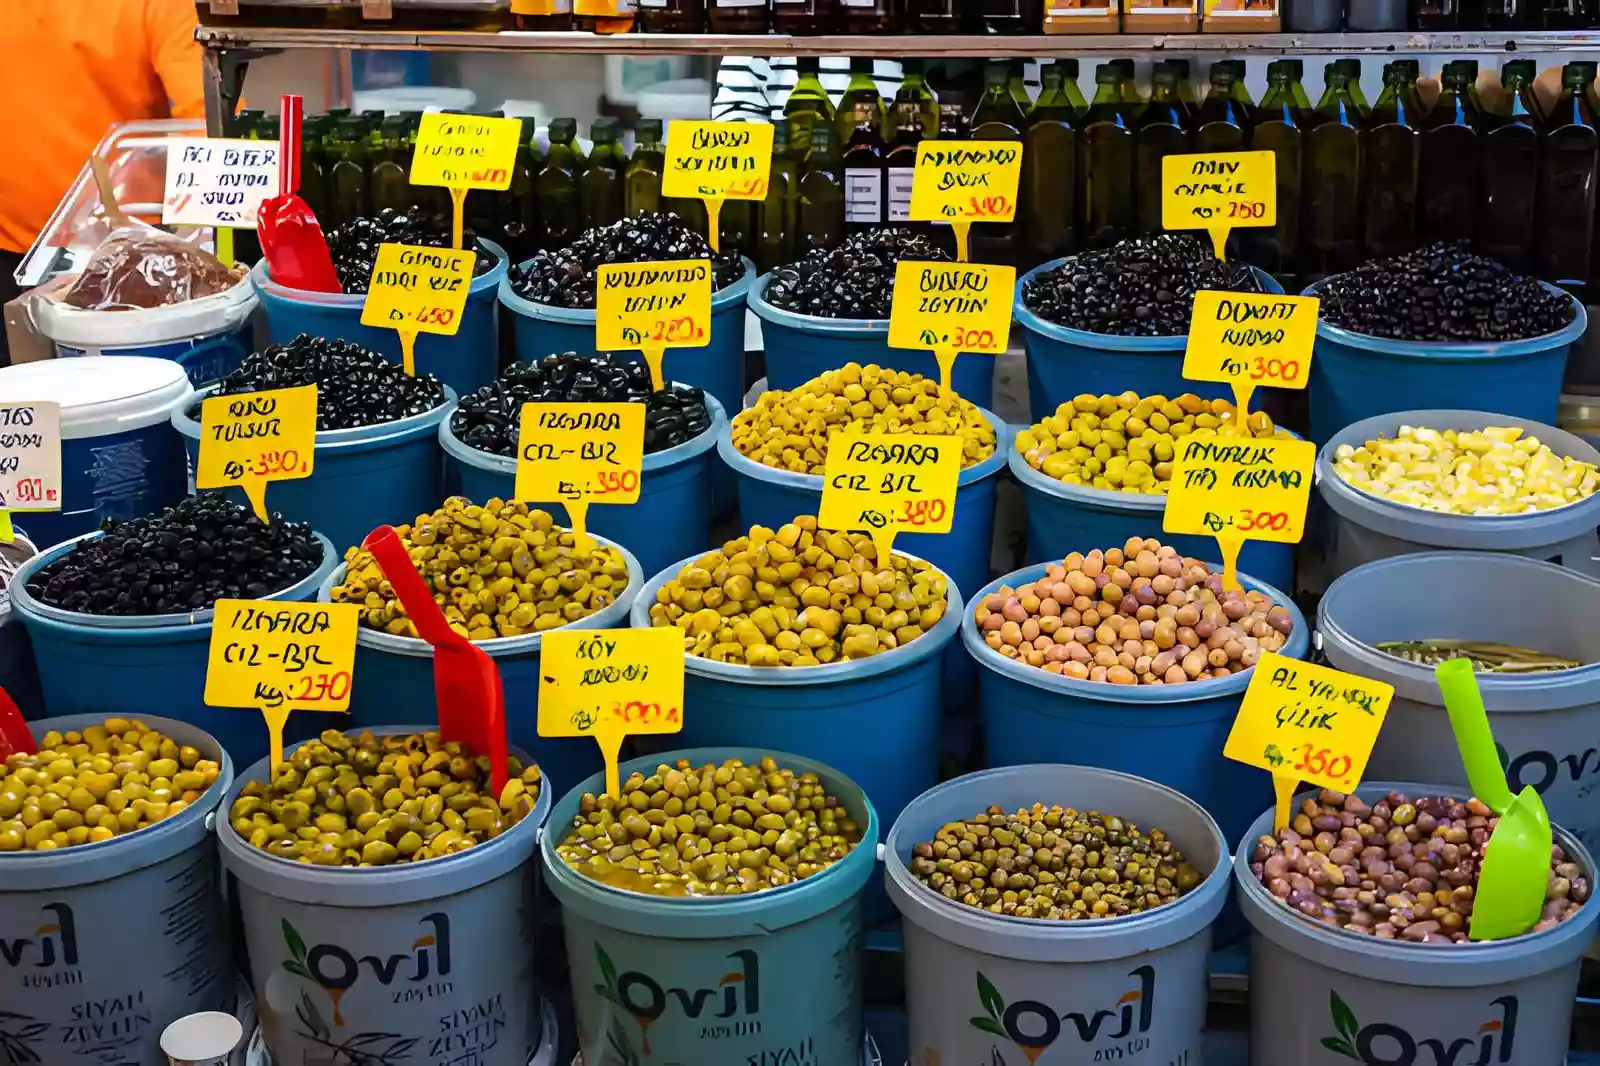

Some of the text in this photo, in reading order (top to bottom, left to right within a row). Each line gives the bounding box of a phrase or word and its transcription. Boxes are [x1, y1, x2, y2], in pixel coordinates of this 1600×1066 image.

[1250, 356, 1300, 381] 300
[1236, 509, 1289, 532] 300
[294, 671, 352, 701] 270
[1506, 746, 1600, 796] Ov
